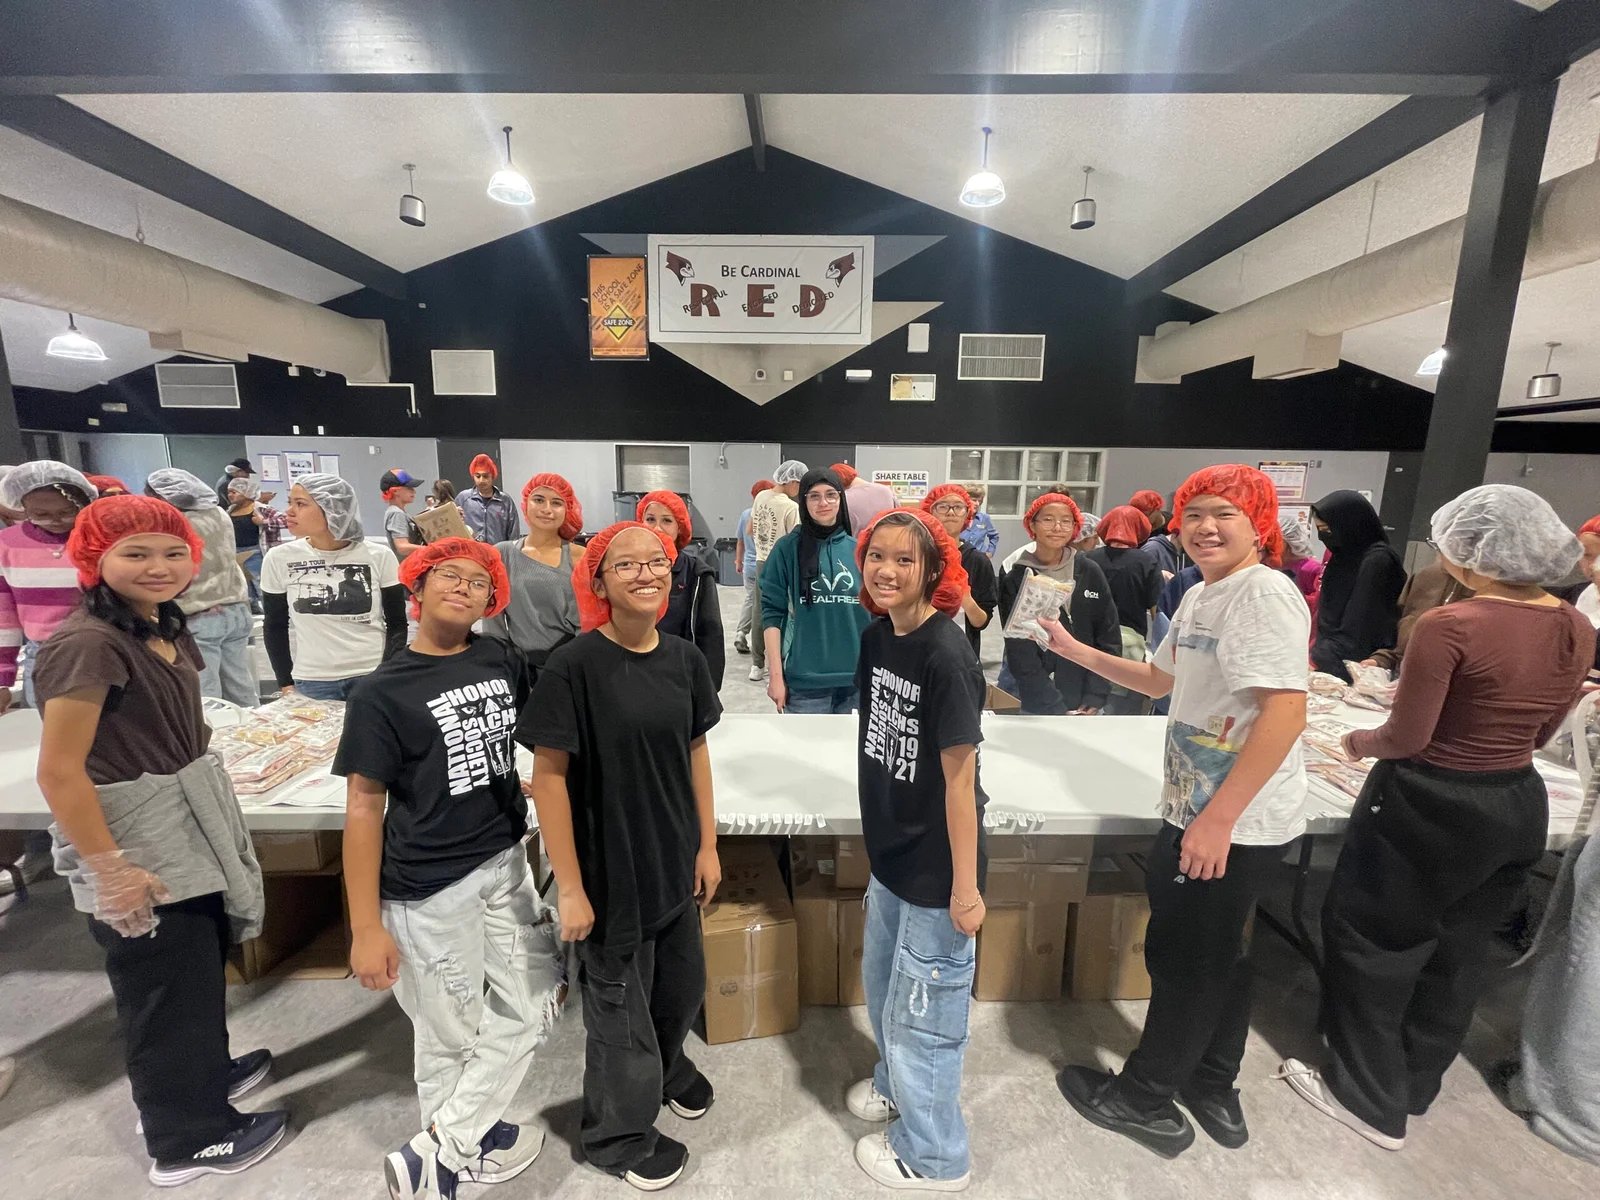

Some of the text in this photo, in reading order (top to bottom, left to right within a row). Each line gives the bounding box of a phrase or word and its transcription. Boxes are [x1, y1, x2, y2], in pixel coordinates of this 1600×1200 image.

[613, 282, 629, 298] SAFE
[628, 262, 644, 284] ZONE
[741, 265, 801, 278] CARDINAL
[592, 283, 606, 299] THIS
[597, 278, 622, 306] SCHOOL
[682, 289, 729, 314] REFUL
[791, 291, 835, 314] DEDICED
[875, 472, 927, 480] SHARE TABLE
[286, 560, 308, 568] WORLD
[447, 678, 511, 707] HONOR
[881, 668, 921, 703] HONOR
[477, 707, 517, 733] LCH
[864, 666, 883, 759] NATIONAL
[887, 705, 919, 736] LCHS
[426, 692, 473, 796] NATIONAL
[874, 699, 888, 766] SOCIETY
[461, 717, 491, 787] SOCIETY
[898, 735, 919, 760] 19
[895, 757, 917, 784] 21
[193, 1142, 234, 1159] HOKA
